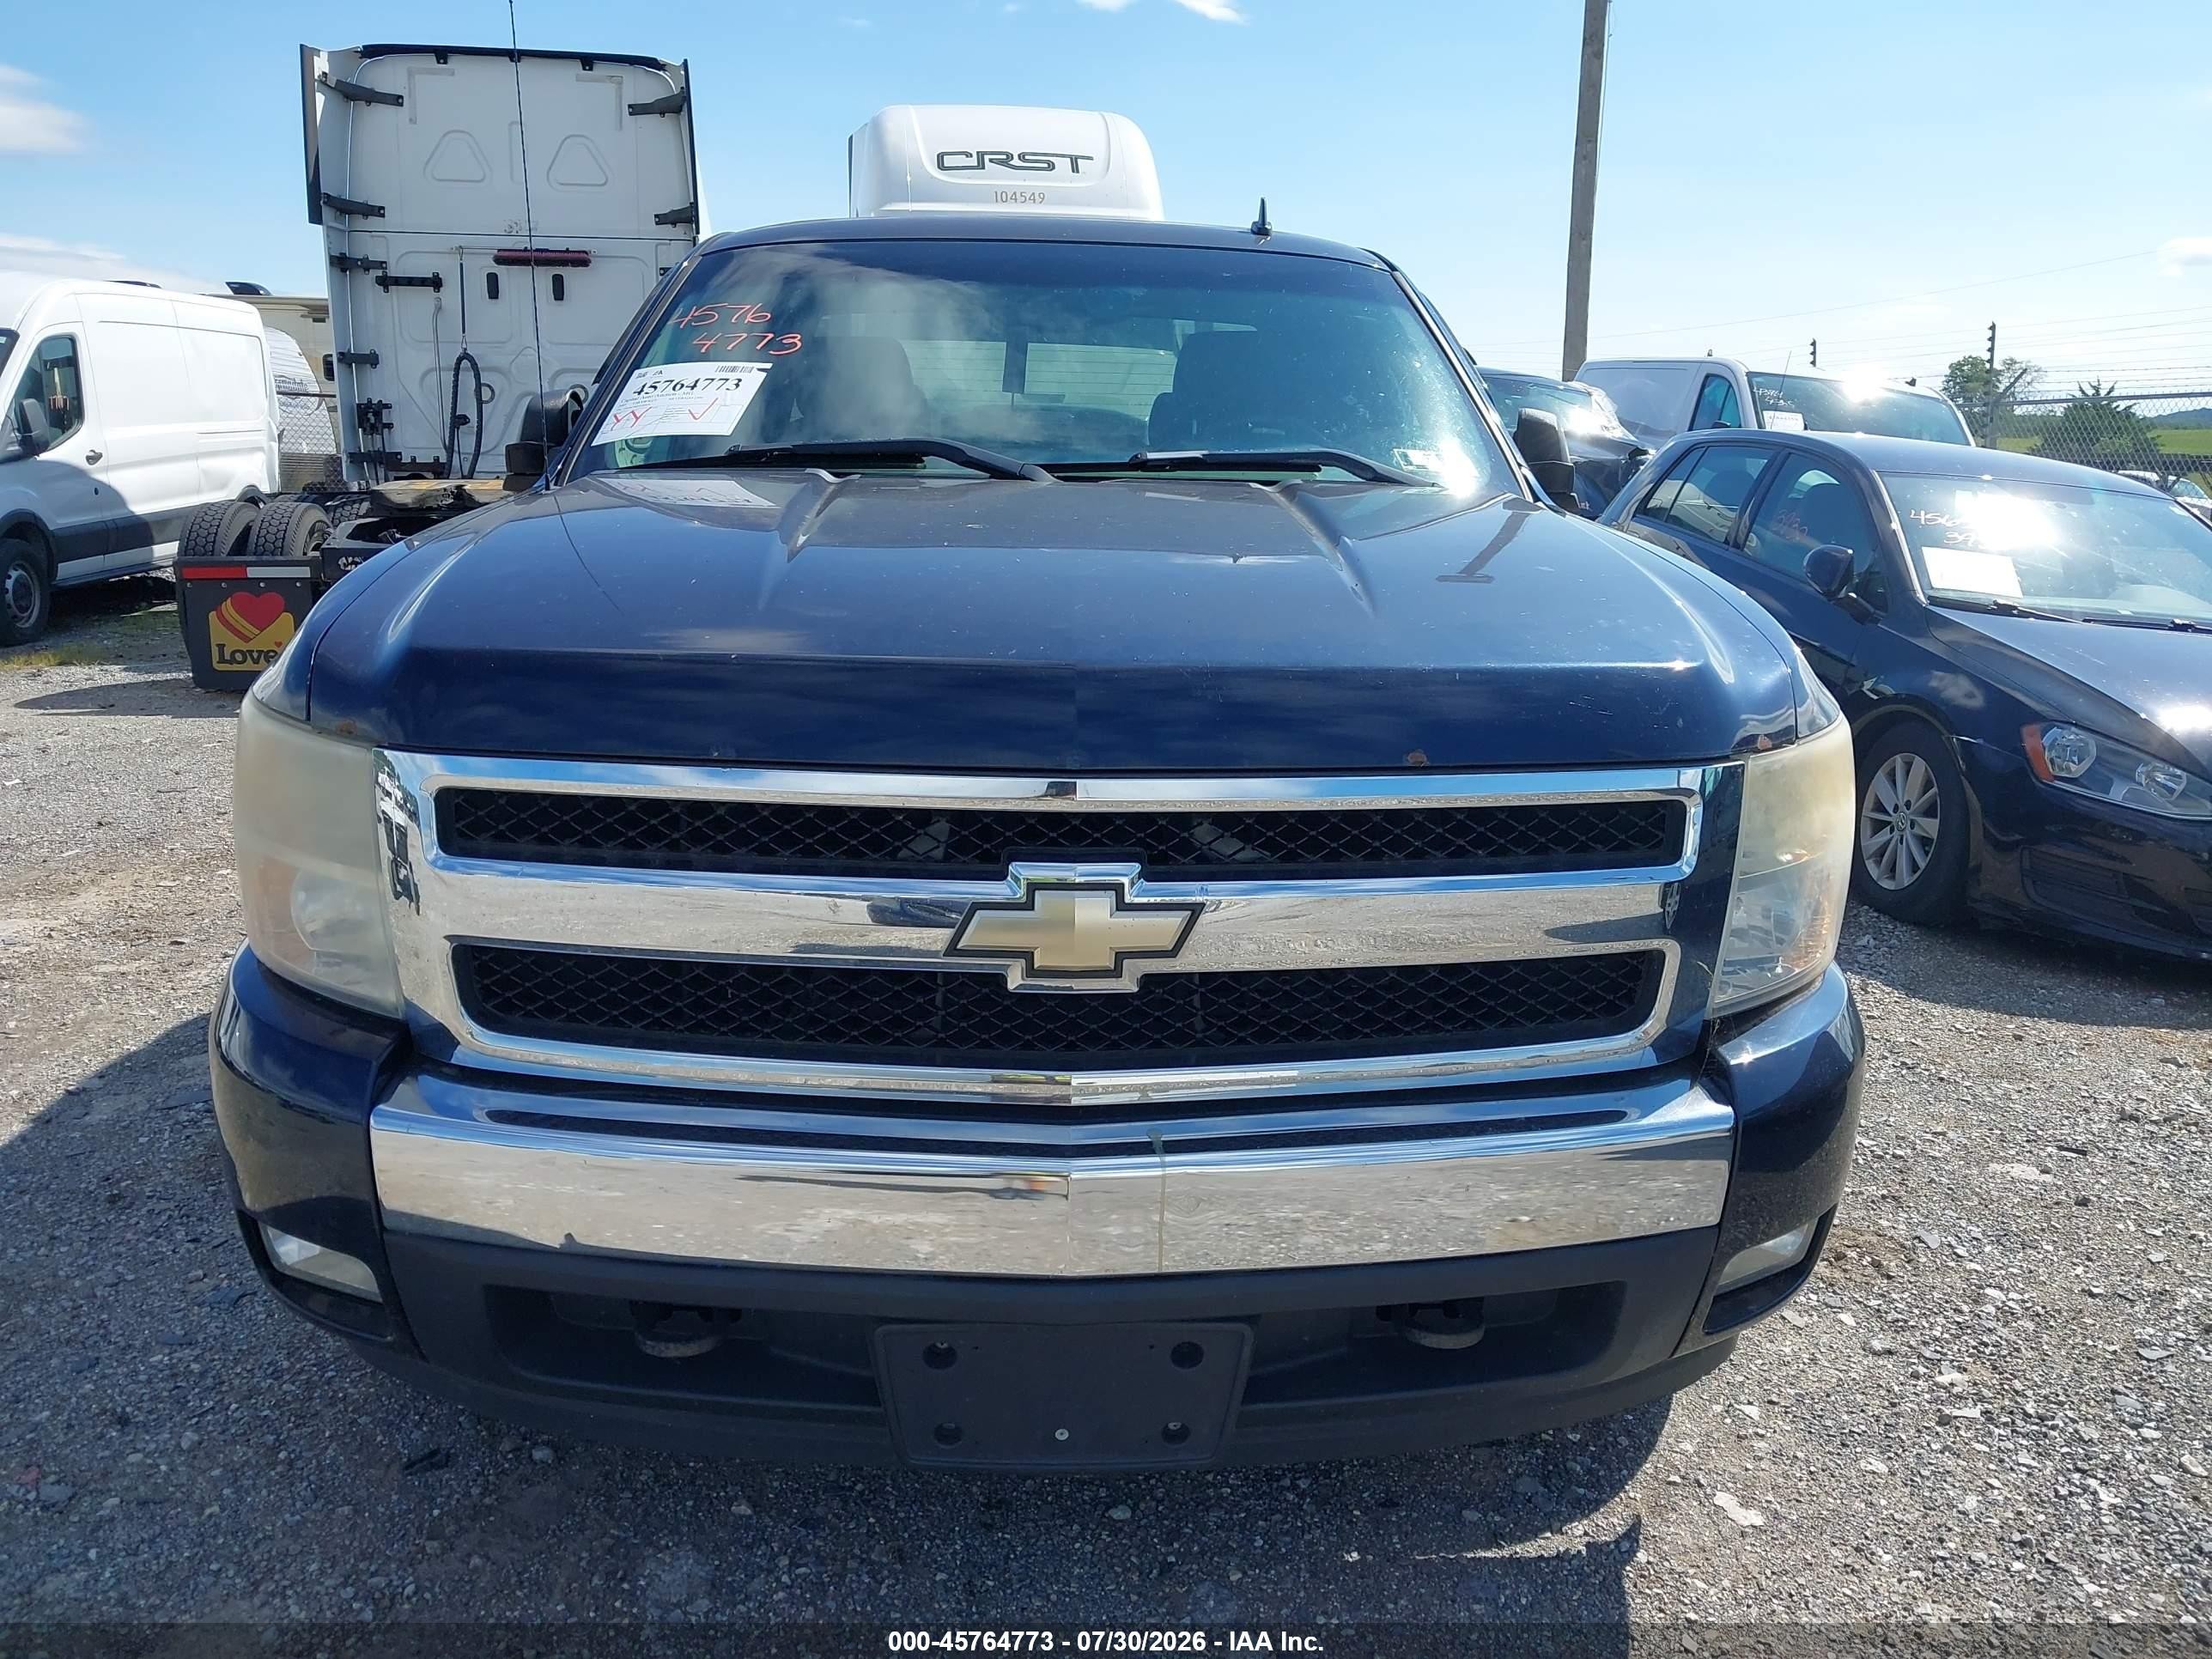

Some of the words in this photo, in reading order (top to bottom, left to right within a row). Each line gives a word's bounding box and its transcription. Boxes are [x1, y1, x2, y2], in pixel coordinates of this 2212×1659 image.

[937, 150, 1094, 174] CRST
[994, 191, 1046, 204] 104549
[668, 302, 772, 329] 4576
[692, 331, 803, 356] 4773
[633, 378, 743, 396] 45764773
[1910, 508, 1966, 527] 456
[216, 643, 278, 665] Love
